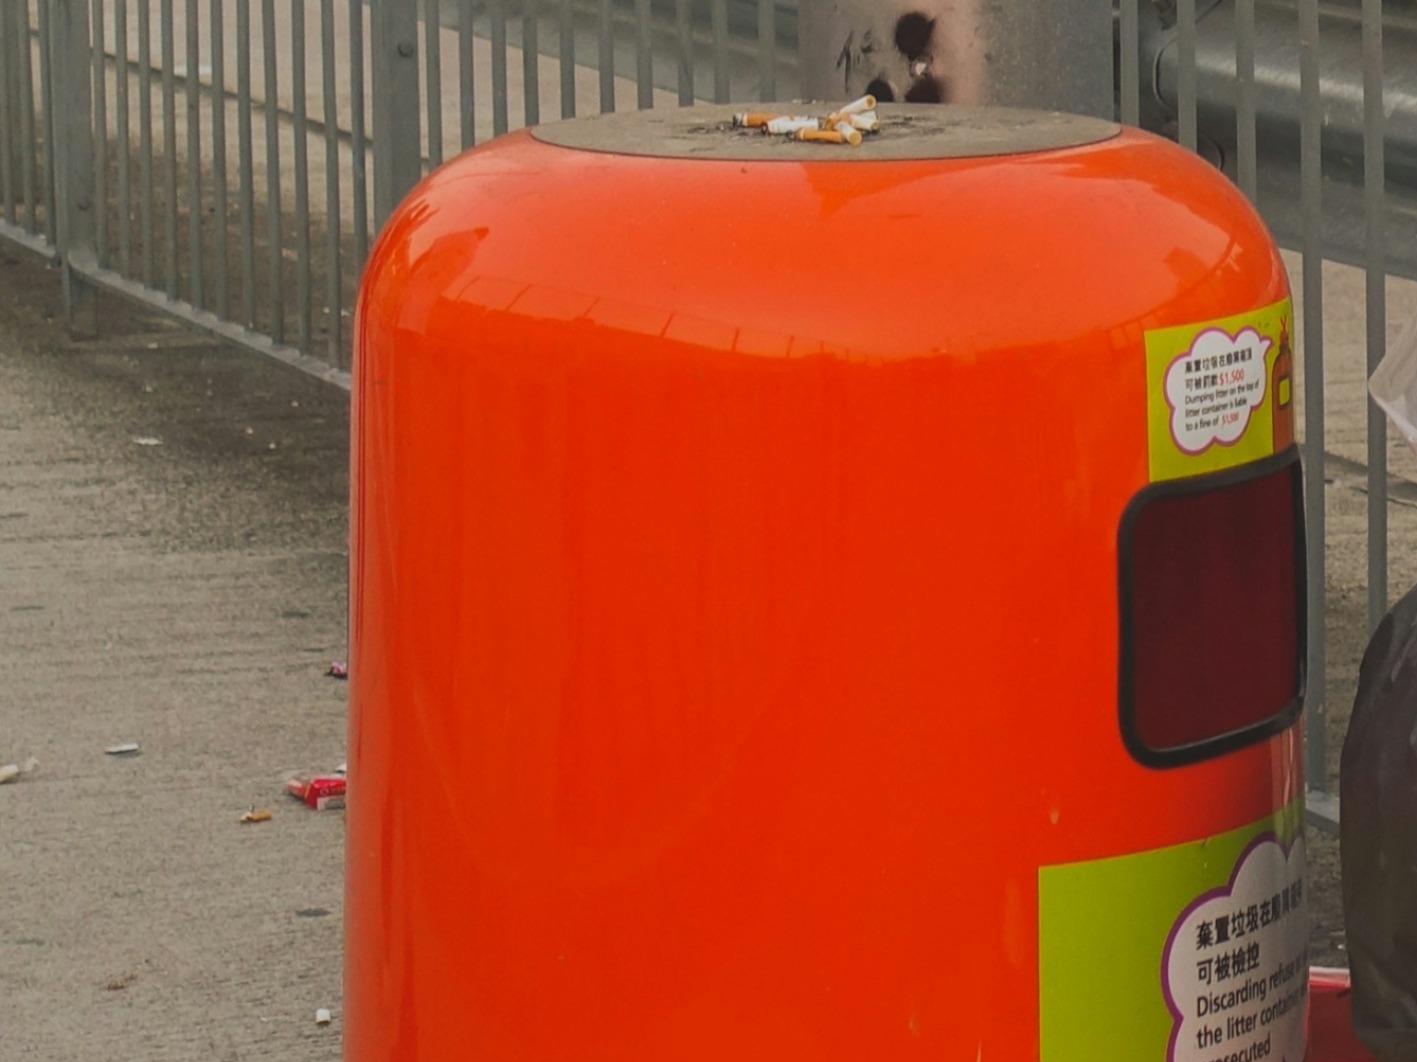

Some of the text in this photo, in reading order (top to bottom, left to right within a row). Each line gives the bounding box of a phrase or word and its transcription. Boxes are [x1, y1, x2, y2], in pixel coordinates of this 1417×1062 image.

[1185, 391, 1214, 405] Dumping
[1215, 388, 1228, 399] litter
[1229, 387, 1237, 396] on
[1237, 384, 1245, 394] the
[1185, 407, 1200, 418] litter
[1202, 402, 1229, 415] container
[1235, 397, 1247, 408] liable
[1186, 422, 1193, 431] to
[1194, 422, 1198, 430] a
[1199, 418, 1211, 428] fine
[1212, 415, 1219, 426] of
[1196, 941, 1260, 986] 可被檢控
[1197, 979, 1267, 1018] Discarding
[1269, 962, 1295, 991] refuse
[1196, 1027, 1223, 1049] the
[1227, 1011, 1257, 1040] litter
